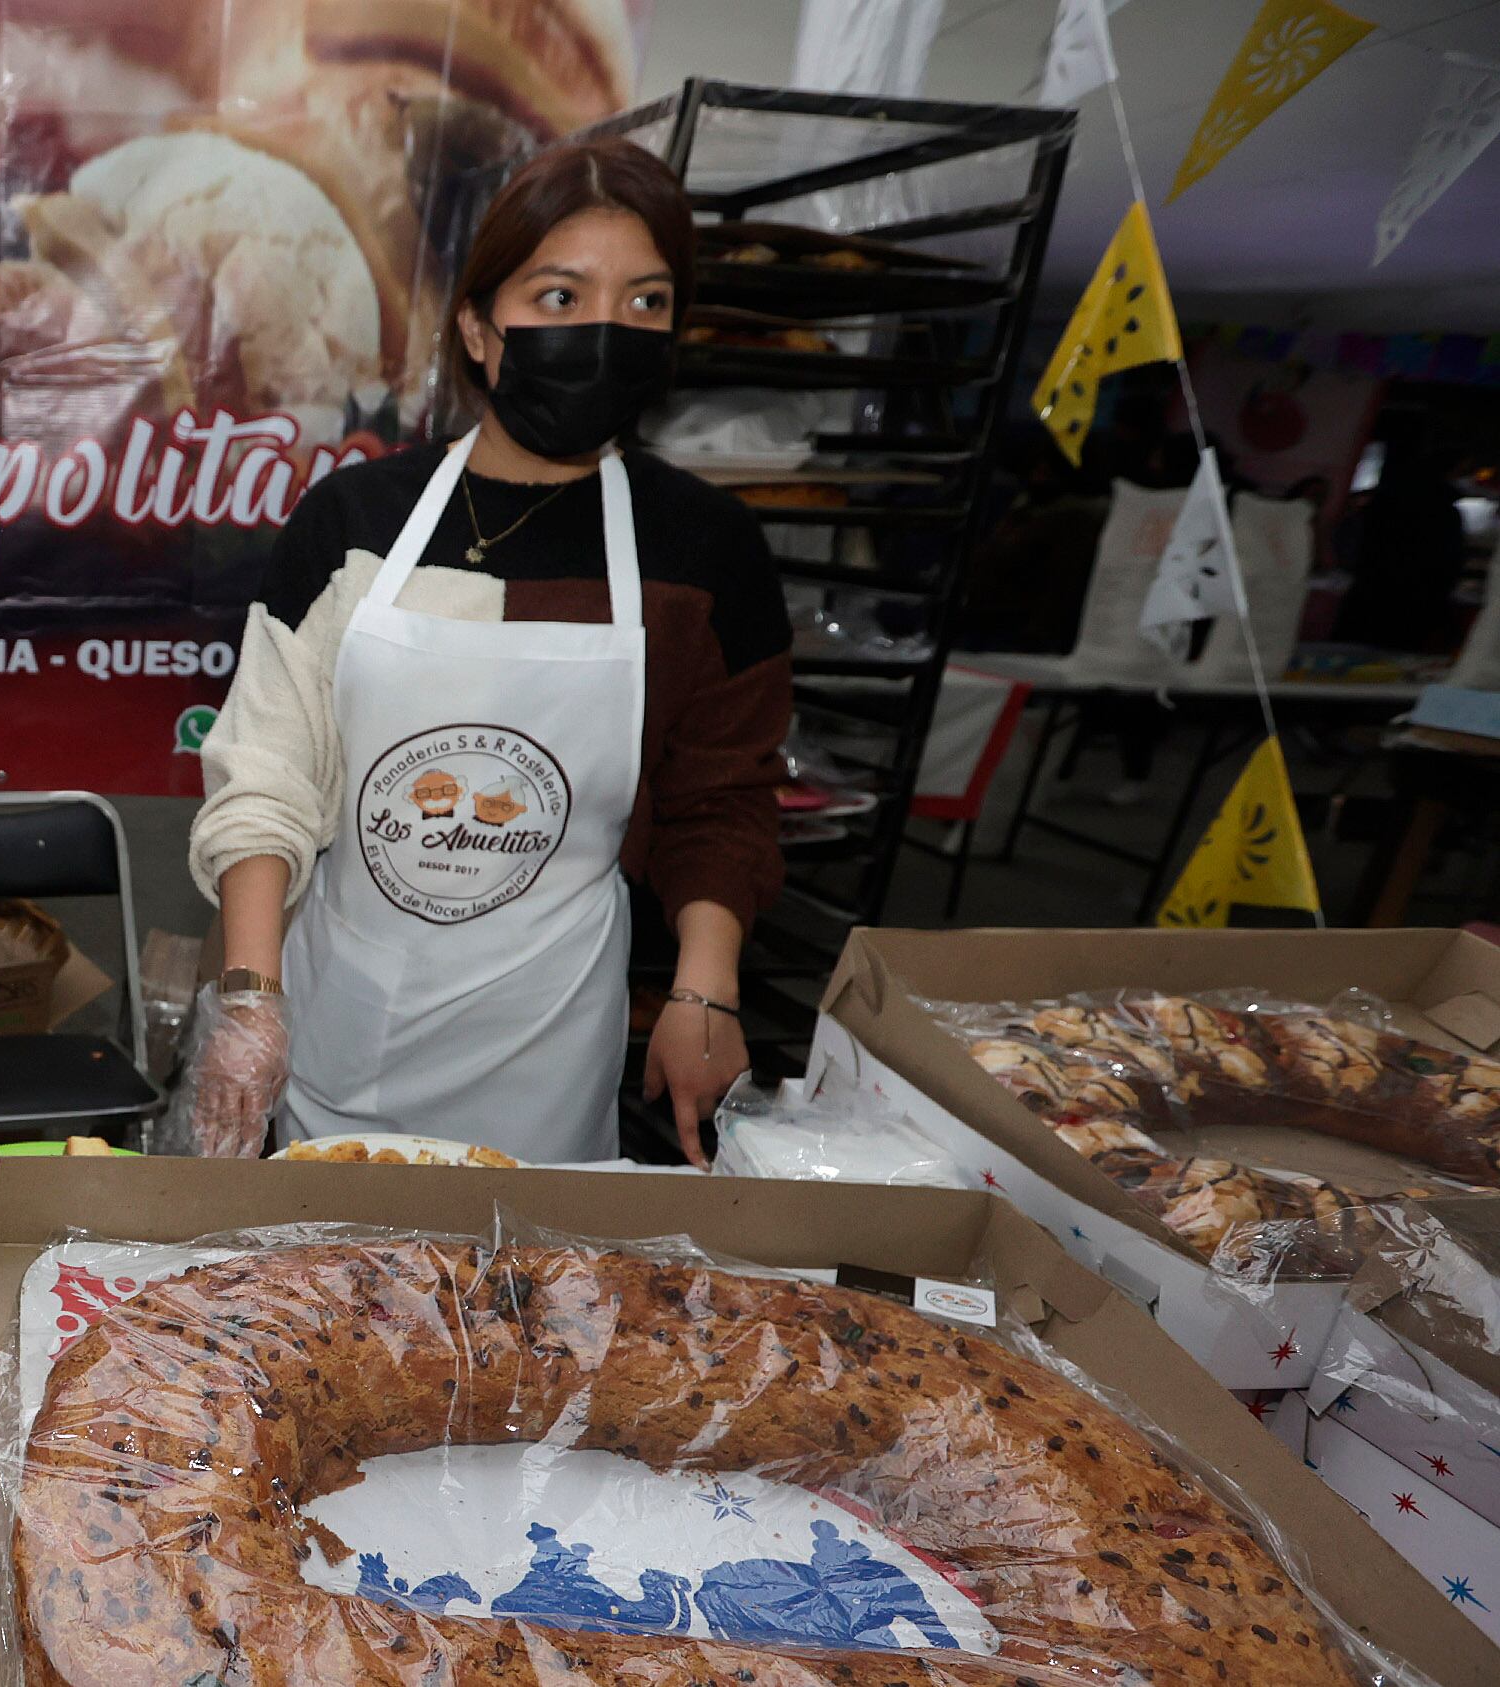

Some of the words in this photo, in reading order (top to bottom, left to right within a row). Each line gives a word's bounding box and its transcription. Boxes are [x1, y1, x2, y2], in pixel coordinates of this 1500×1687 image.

[76, 638, 236, 681] QUESO
[457, 735, 468, 749] S
[474, 735, 488, 749] &
[493, 737, 506, 753] R
[366, 808, 412, 843] Los
[421, 822, 553, 854] Abuelitos
[366, 845, 381, 858] El
[418, 861, 451, 873] DESDE
[454, 864, 481, 876] 2017
[371, 861, 402, 896] gusto
[402, 894, 421, 908] de
[424, 899, 469, 917] hacer
[472, 902, 488, 913] lo
